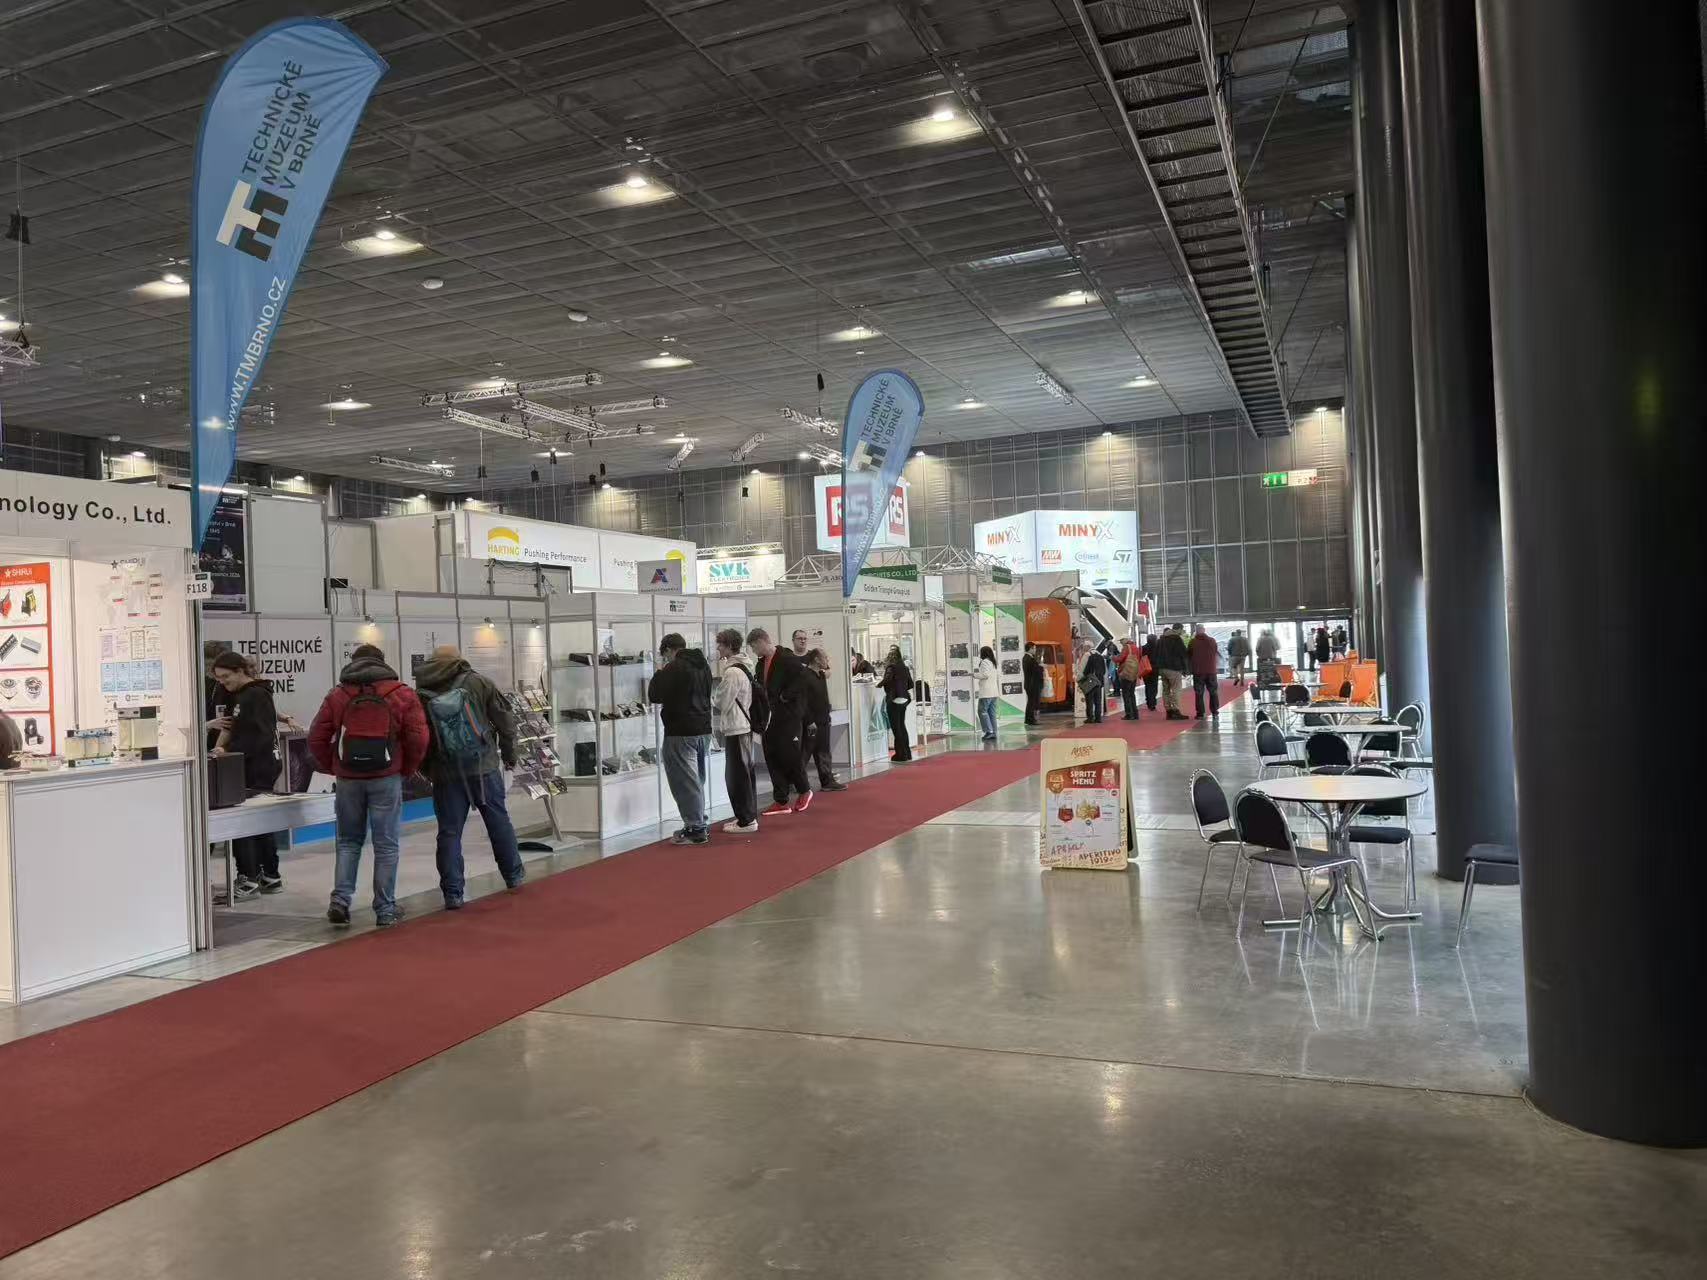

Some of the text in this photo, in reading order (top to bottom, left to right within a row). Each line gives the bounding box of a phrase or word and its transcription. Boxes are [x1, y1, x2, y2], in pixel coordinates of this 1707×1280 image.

[242, 60, 303, 174] TECHNICKÉ
[261, 92, 311, 186] MUZEUM
[279, 115, 321, 190] V BRNĚ
[861, 378, 889, 437] TECHNICKÉ
[872, 395, 896, 443] MUZEUM
[881, 407, 904, 445] V BRNĚ
[86, 501, 127, 524] Co.,
[134, 505, 171, 525] Ltd.
[889, 494, 904, 526] RS
[1059, 520, 1115, 540] MINYX
[488, 544, 519, 556] HARTING
[524, 548, 587, 563] Pushing Performance
[709, 562, 749, 578] SVK
[186, 583, 208, 594] F118
[238, 636, 322, 655] TECHNICKÉ
[260, 659, 305, 674] UZEUM
[1070, 770, 1096, 778] SPRITZ
[1079, 849, 1120, 860] APERITIVO
